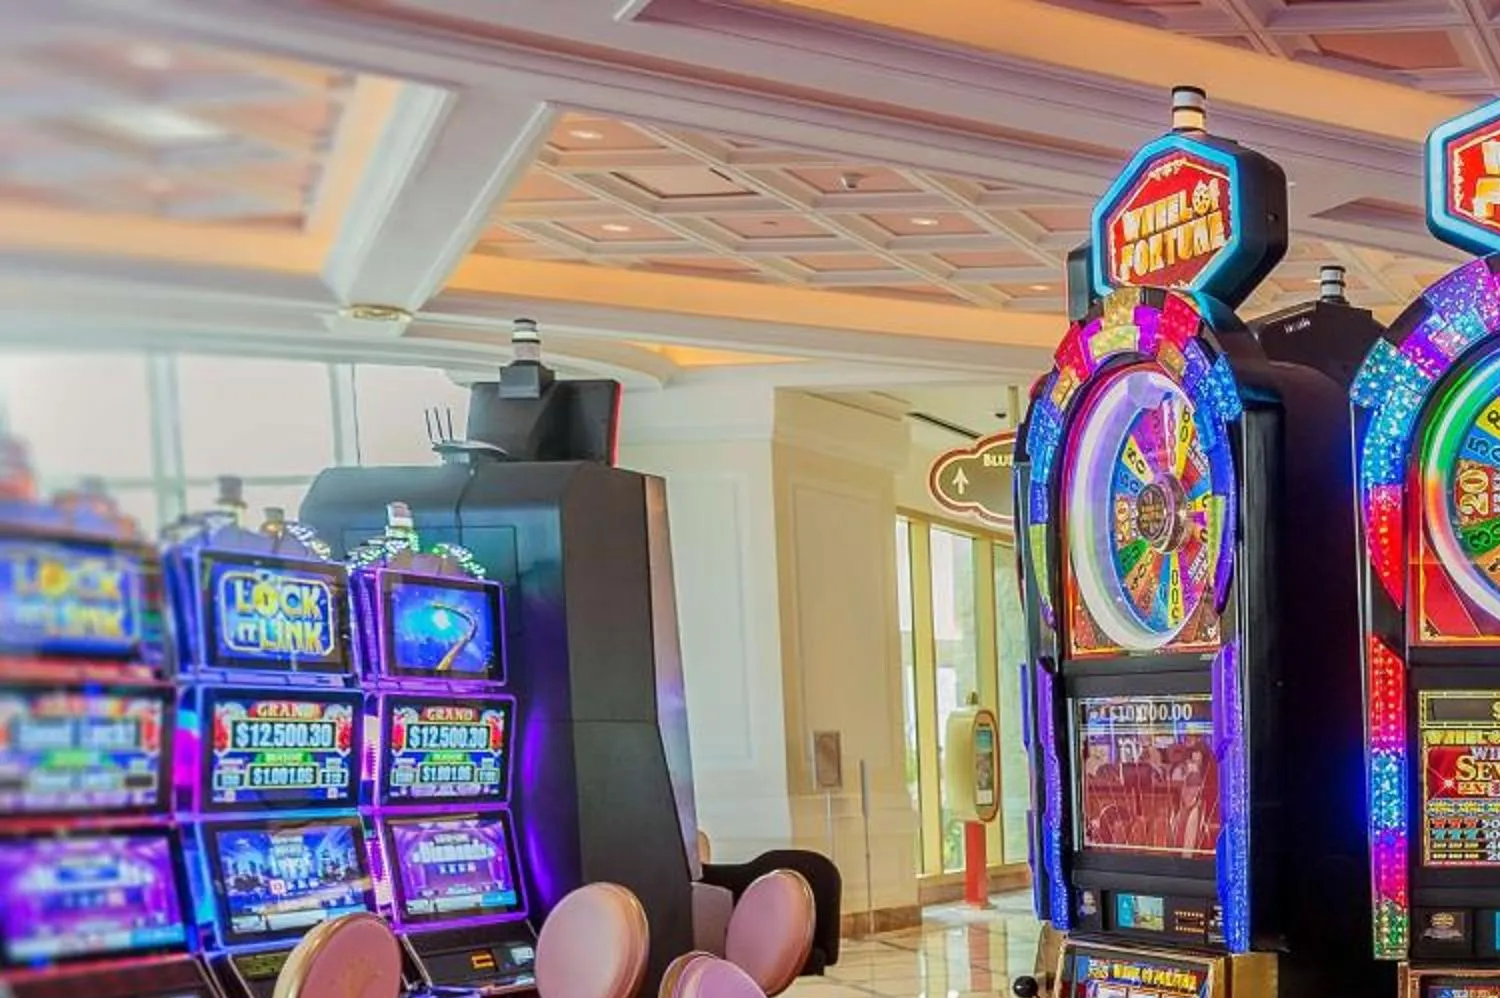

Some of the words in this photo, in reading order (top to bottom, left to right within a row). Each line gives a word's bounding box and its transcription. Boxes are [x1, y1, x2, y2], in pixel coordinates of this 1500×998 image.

[1122, 190, 1192, 242] WHEEL
[1119, 211, 1227, 282] FORTUNE
[1459, 468, 1490, 516] 20
[235, 579, 322, 619] LOCK
[260, 620, 323, 652] LINK
[427, 708, 473, 721] GRAND
